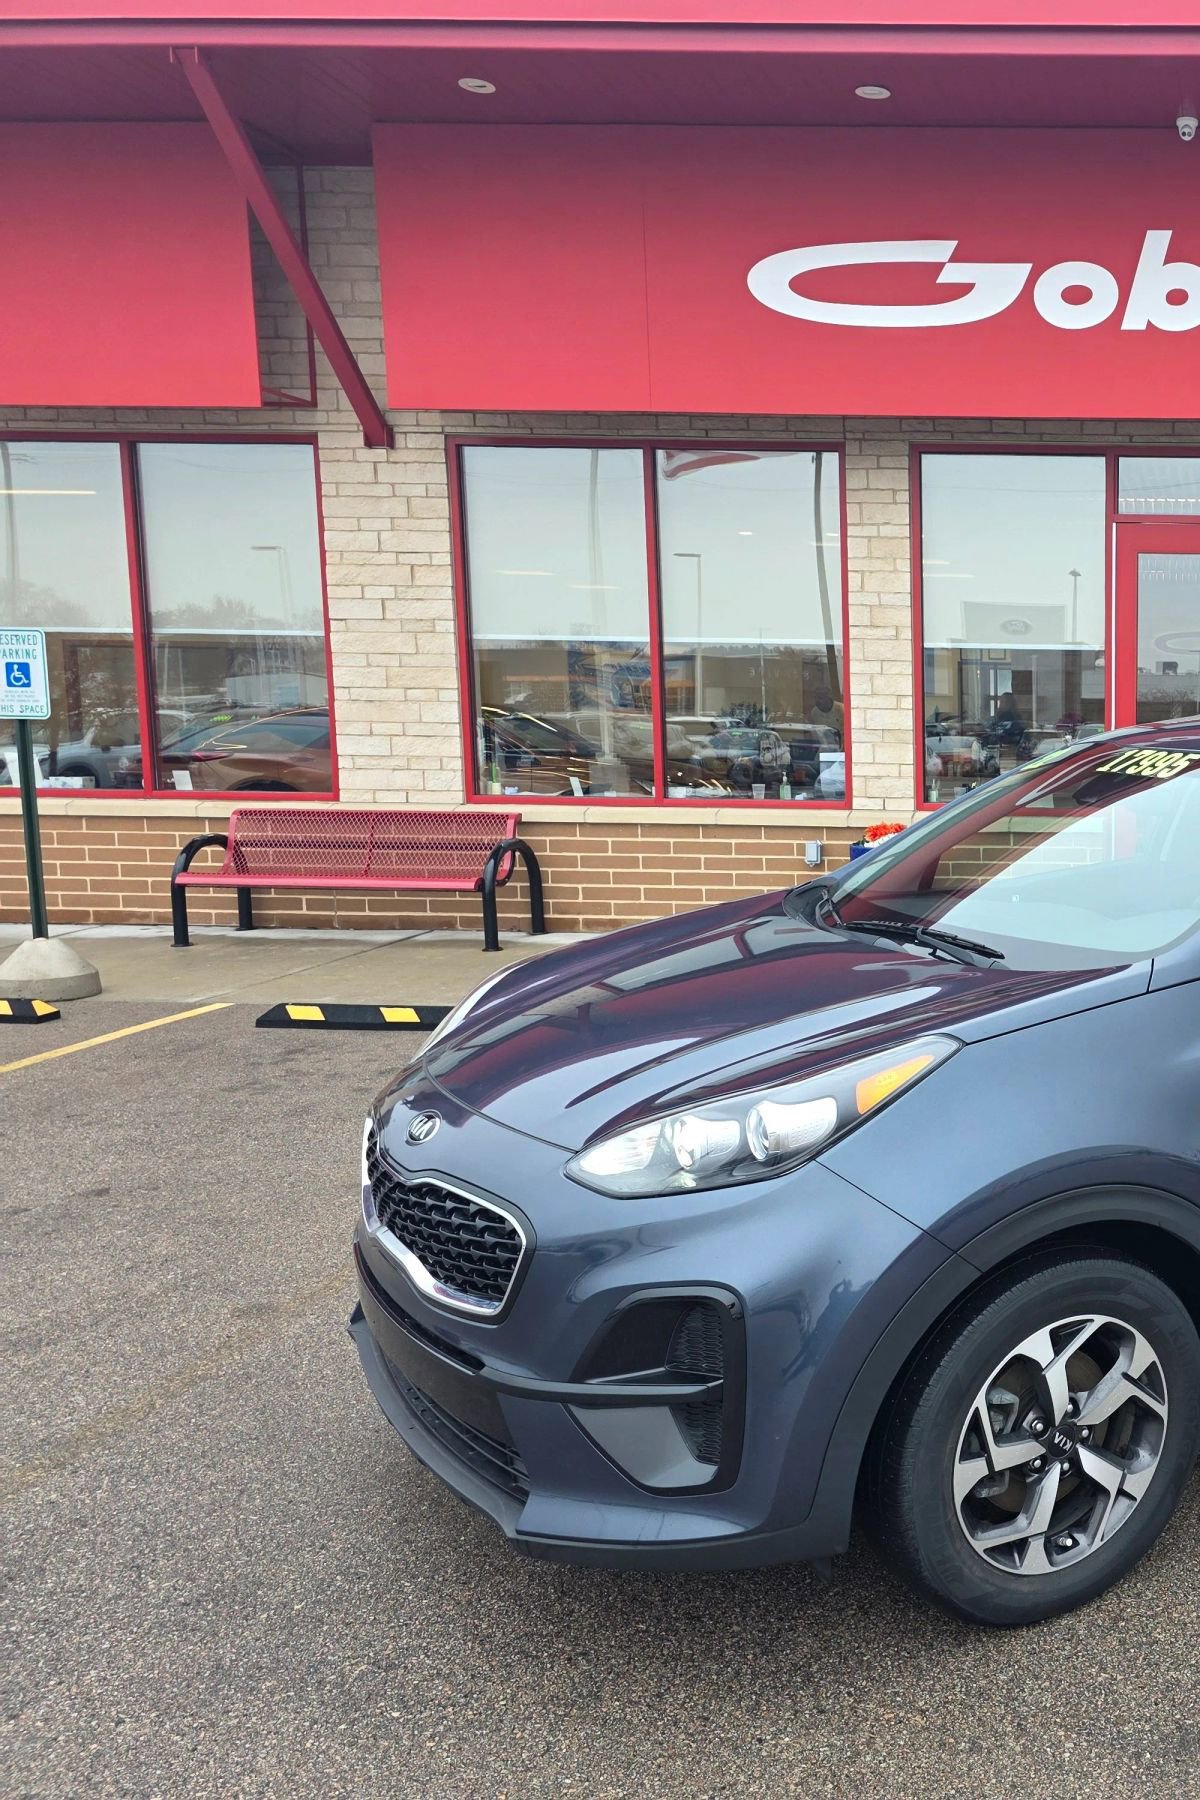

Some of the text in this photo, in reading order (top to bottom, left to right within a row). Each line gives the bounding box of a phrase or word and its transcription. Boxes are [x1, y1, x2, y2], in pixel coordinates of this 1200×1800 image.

[0, 634, 37, 645] ESERVED
[0, 649, 37, 660] ARKING
[0, 704, 45, 713] HIS SPACE
[410, 1115, 433, 1140] KIA
[1054, 1432, 1073, 1451] KIA
